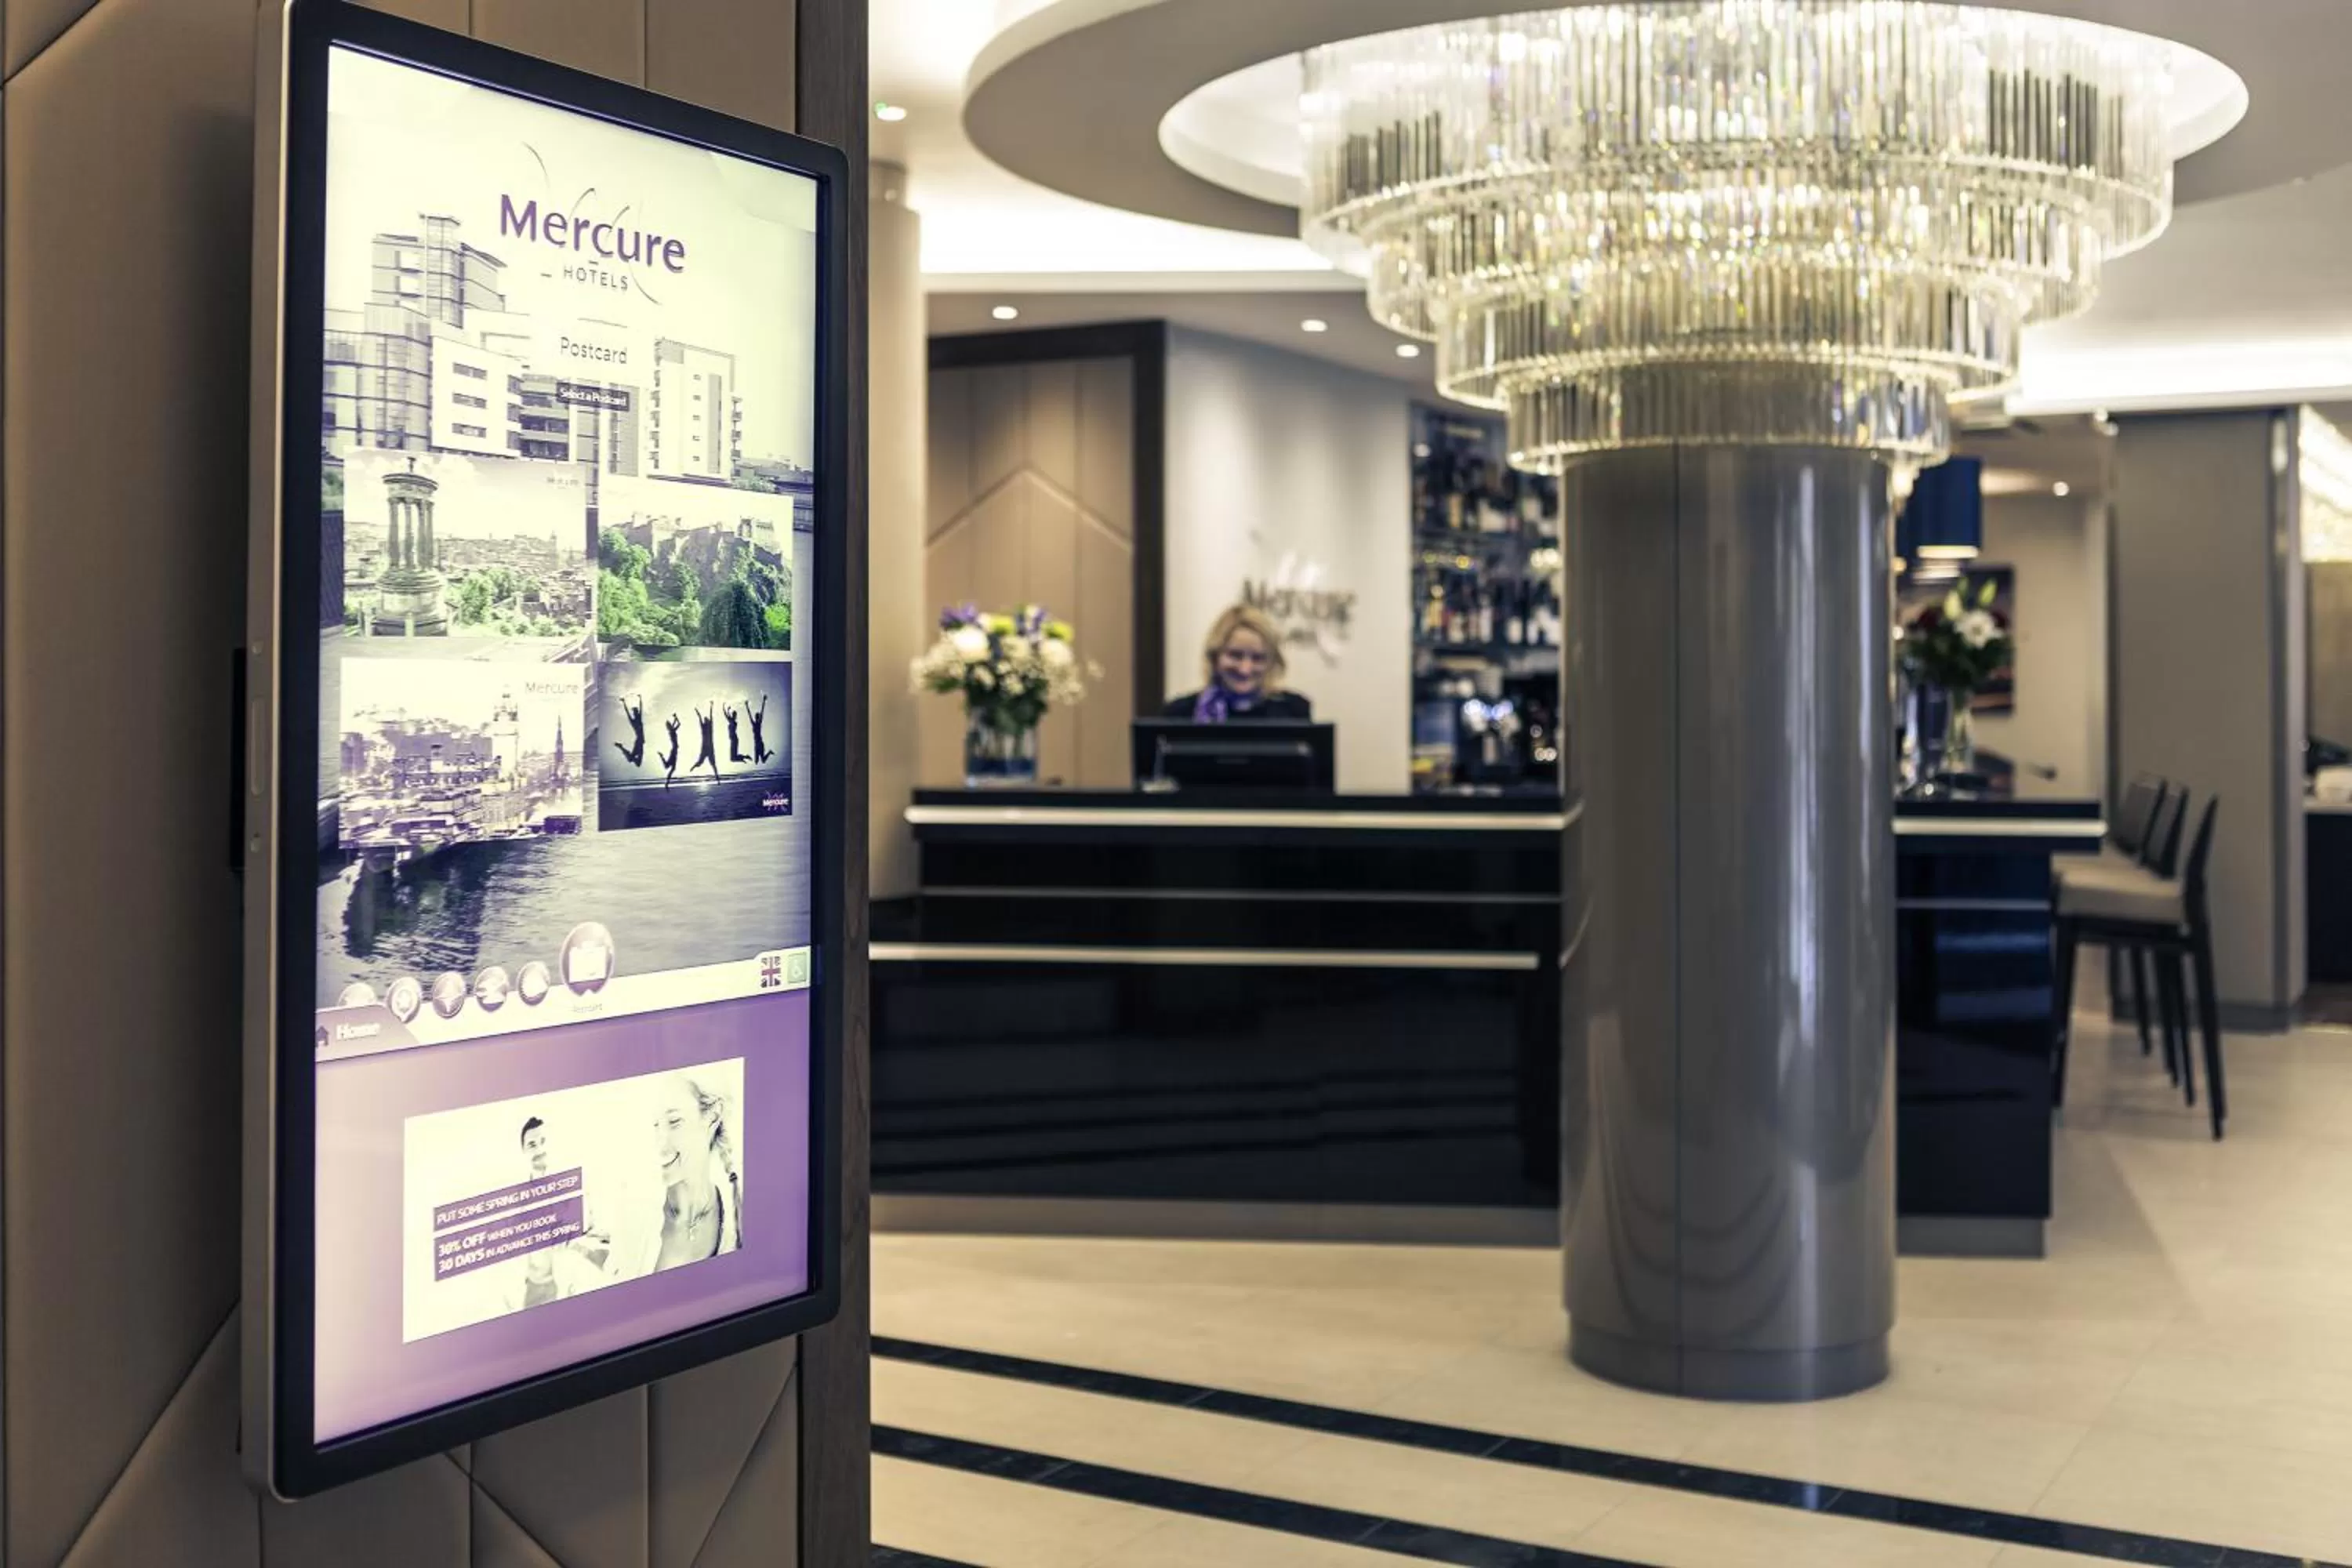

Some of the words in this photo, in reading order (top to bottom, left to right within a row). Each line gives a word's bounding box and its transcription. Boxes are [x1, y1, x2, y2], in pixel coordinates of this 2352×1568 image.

[500, 194, 685, 274] Mercure
[563, 266, 628, 291] HOTELS
[561, 336, 627, 364] Postcard
[336, 1022, 380, 1040] Home
[437, 1210, 456, 1225] PUT
[458, 1201, 485, 1218] SOME
[485, 1192, 519, 1209] SPRING
[521, 1189, 530, 1201] IN
[530, 1181, 557, 1197] YOUR
[557, 1175, 579, 1190] STEP
[463, 1232, 486, 1248] OFF
[514, 1221, 532, 1233] YOU
[439, 1258, 454, 1273] 30
[456, 1247, 485, 1268] DAYS
